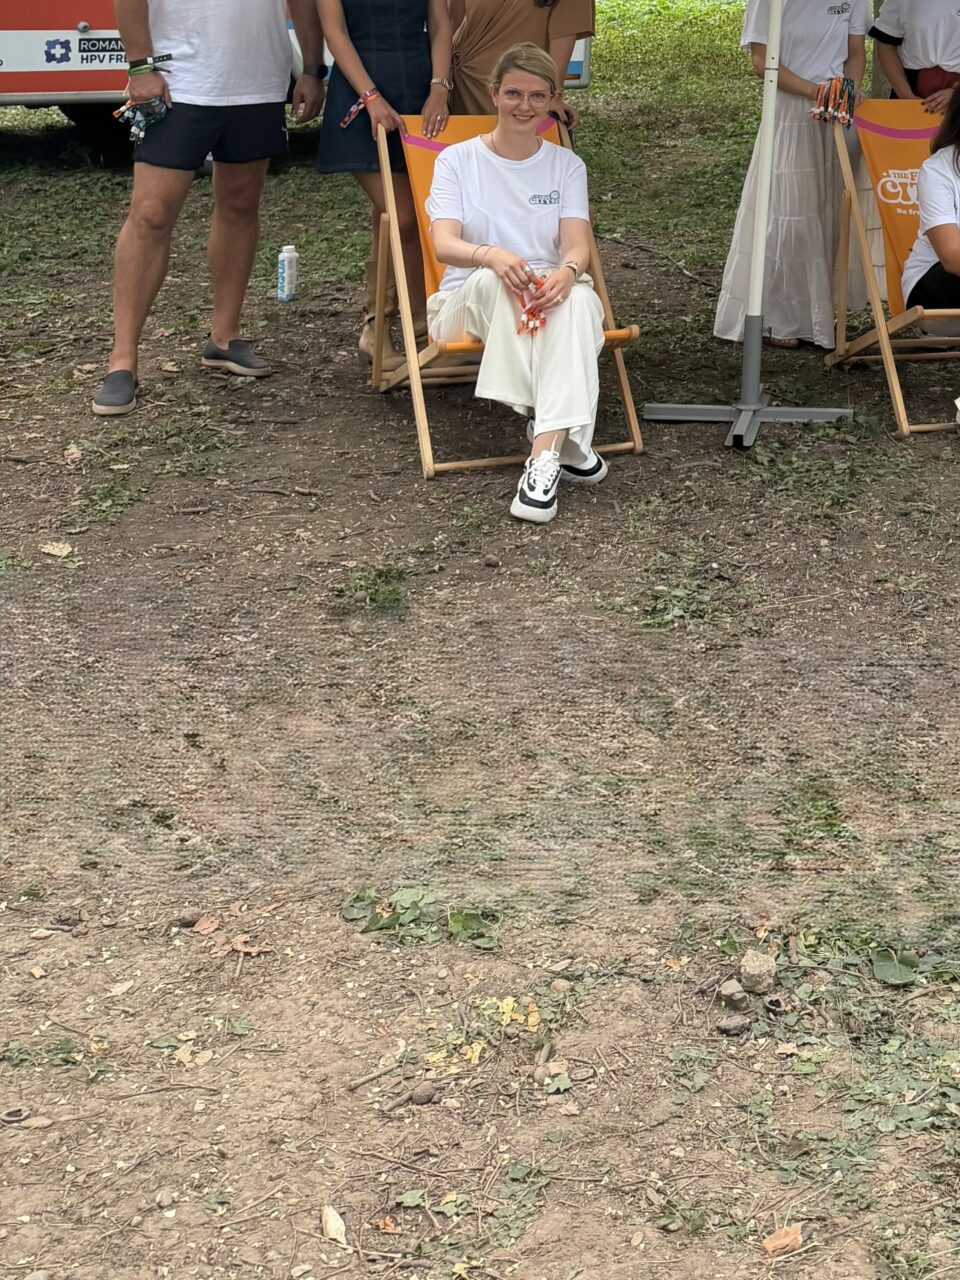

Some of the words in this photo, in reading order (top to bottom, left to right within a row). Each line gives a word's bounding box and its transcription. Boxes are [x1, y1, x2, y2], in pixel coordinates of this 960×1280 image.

[80, 40, 126, 52] ROMAN
[81, 53, 107, 64] HPV
[108, 53, 128, 64] FRE
